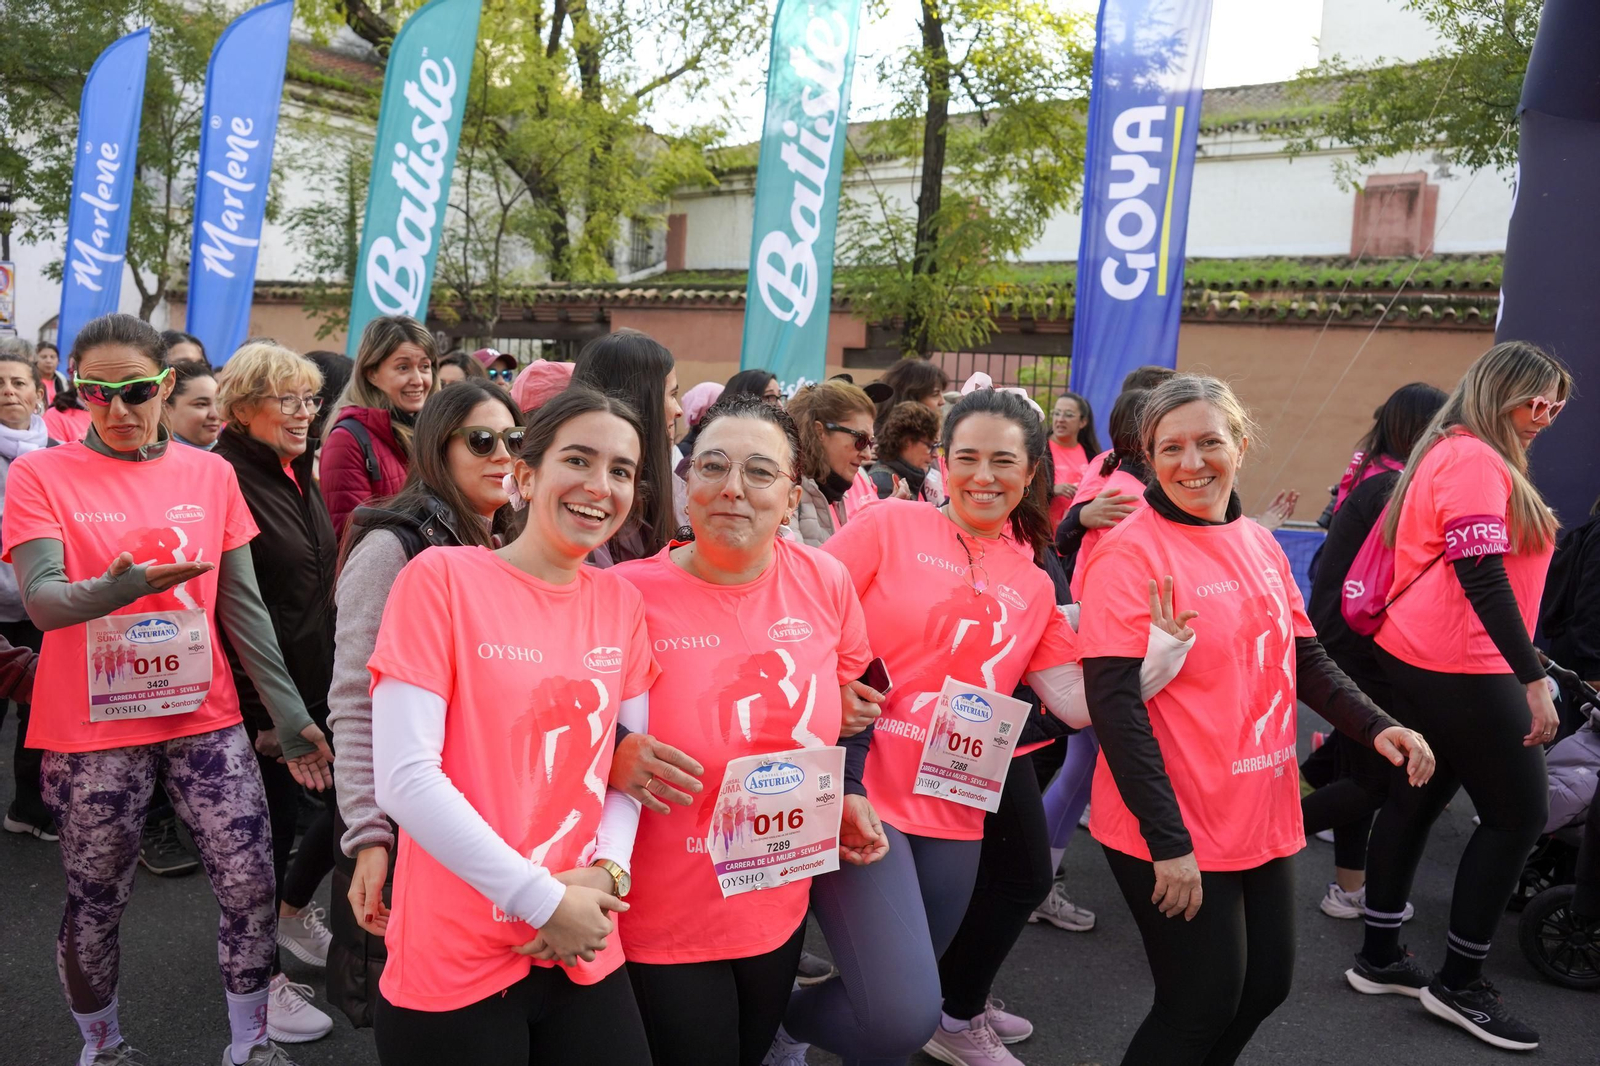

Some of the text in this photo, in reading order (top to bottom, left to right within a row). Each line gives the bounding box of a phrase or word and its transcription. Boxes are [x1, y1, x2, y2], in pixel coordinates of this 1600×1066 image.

[756, 10, 850, 327] Batiste
[365, 56, 457, 318] Batiste
[199, 116, 259, 279] Marlene
[1100, 105, 1167, 301] GOYA
[71, 142, 123, 292] Marlene
[73, 512, 126, 523] OYSHO
[917, 552, 965, 576] OYSHO
[1196, 580, 1240, 598] OYSHO
[97, 634, 122, 642] SUMA
[130, 628, 175, 640] ASTURIANA
[654, 634, 720, 652] OYSHO
[477, 642, 543, 664] OYSHO
[133, 655, 179, 675] 016
[109, 694, 136, 702] CARRERA
[179, 685, 200, 694] SEVILLA
[147, 679, 169, 689] 3420
[105, 704, 147, 715] OYSHO
[953, 699, 989, 719] ASTURIANA
[874, 716, 926, 743] CARRERA
[948, 732, 983, 758] 016
[949, 760, 968, 772] 7288
[1231, 753, 1273, 776] CARRERA
[749, 773, 801, 790] ASTURIANA
[957, 788, 988, 803] Santander
[753, 808, 804, 836] 016
[767, 840, 790, 853] 7289
[725, 859, 756, 871] CARRERA
[776, 852, 797, 863] MUJER
[800, 844, 822, 856] SEVILLA
[789, 859, 825, 874] Santander
[721, 872, 764, 889] OYSHO
